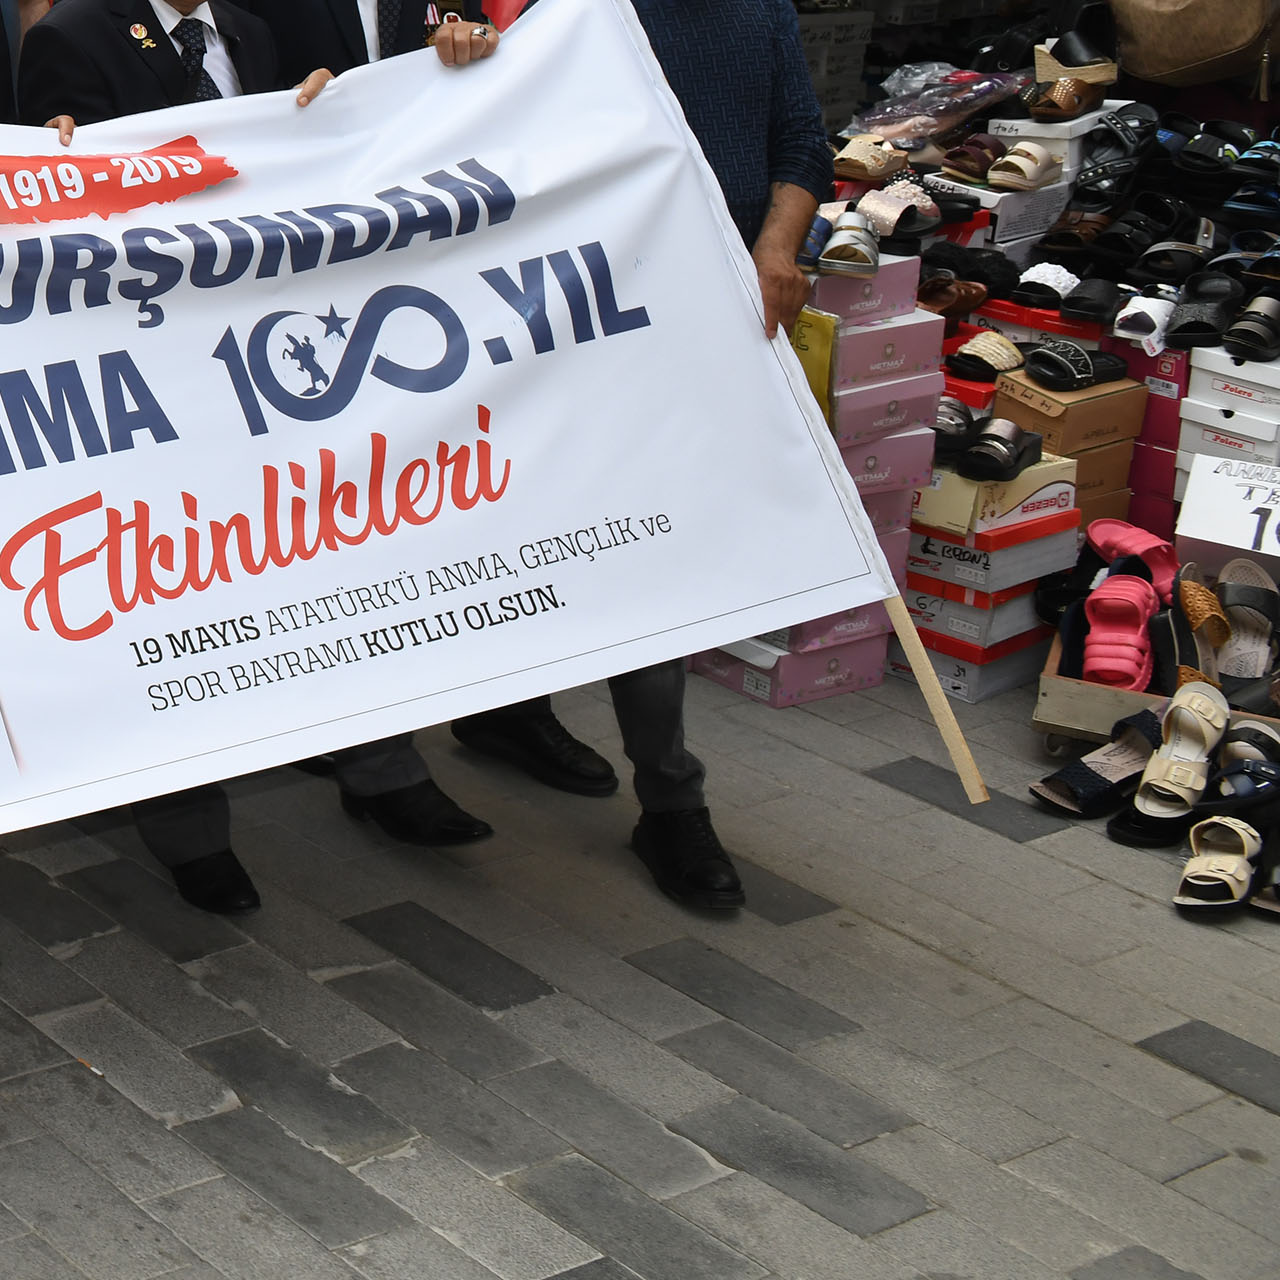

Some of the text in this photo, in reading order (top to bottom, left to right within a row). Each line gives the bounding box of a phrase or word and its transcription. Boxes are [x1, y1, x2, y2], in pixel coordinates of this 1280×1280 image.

[109, 153, 203, 190] 2019
[1220, 383, 1254, 399] Polero
[1212, 434, 1244, 449] Polero
[1021, 493, 1058, 513] GEZER
[1250, 506, 1280, 551] 1
[128, 511, 673, 668] 19 MAYIS ATATÜRK'Ü ANMA, GENÇLİK ve
[146, 583, 568, 712] SPOR BAYRAMI KUTLU OLSUN.
